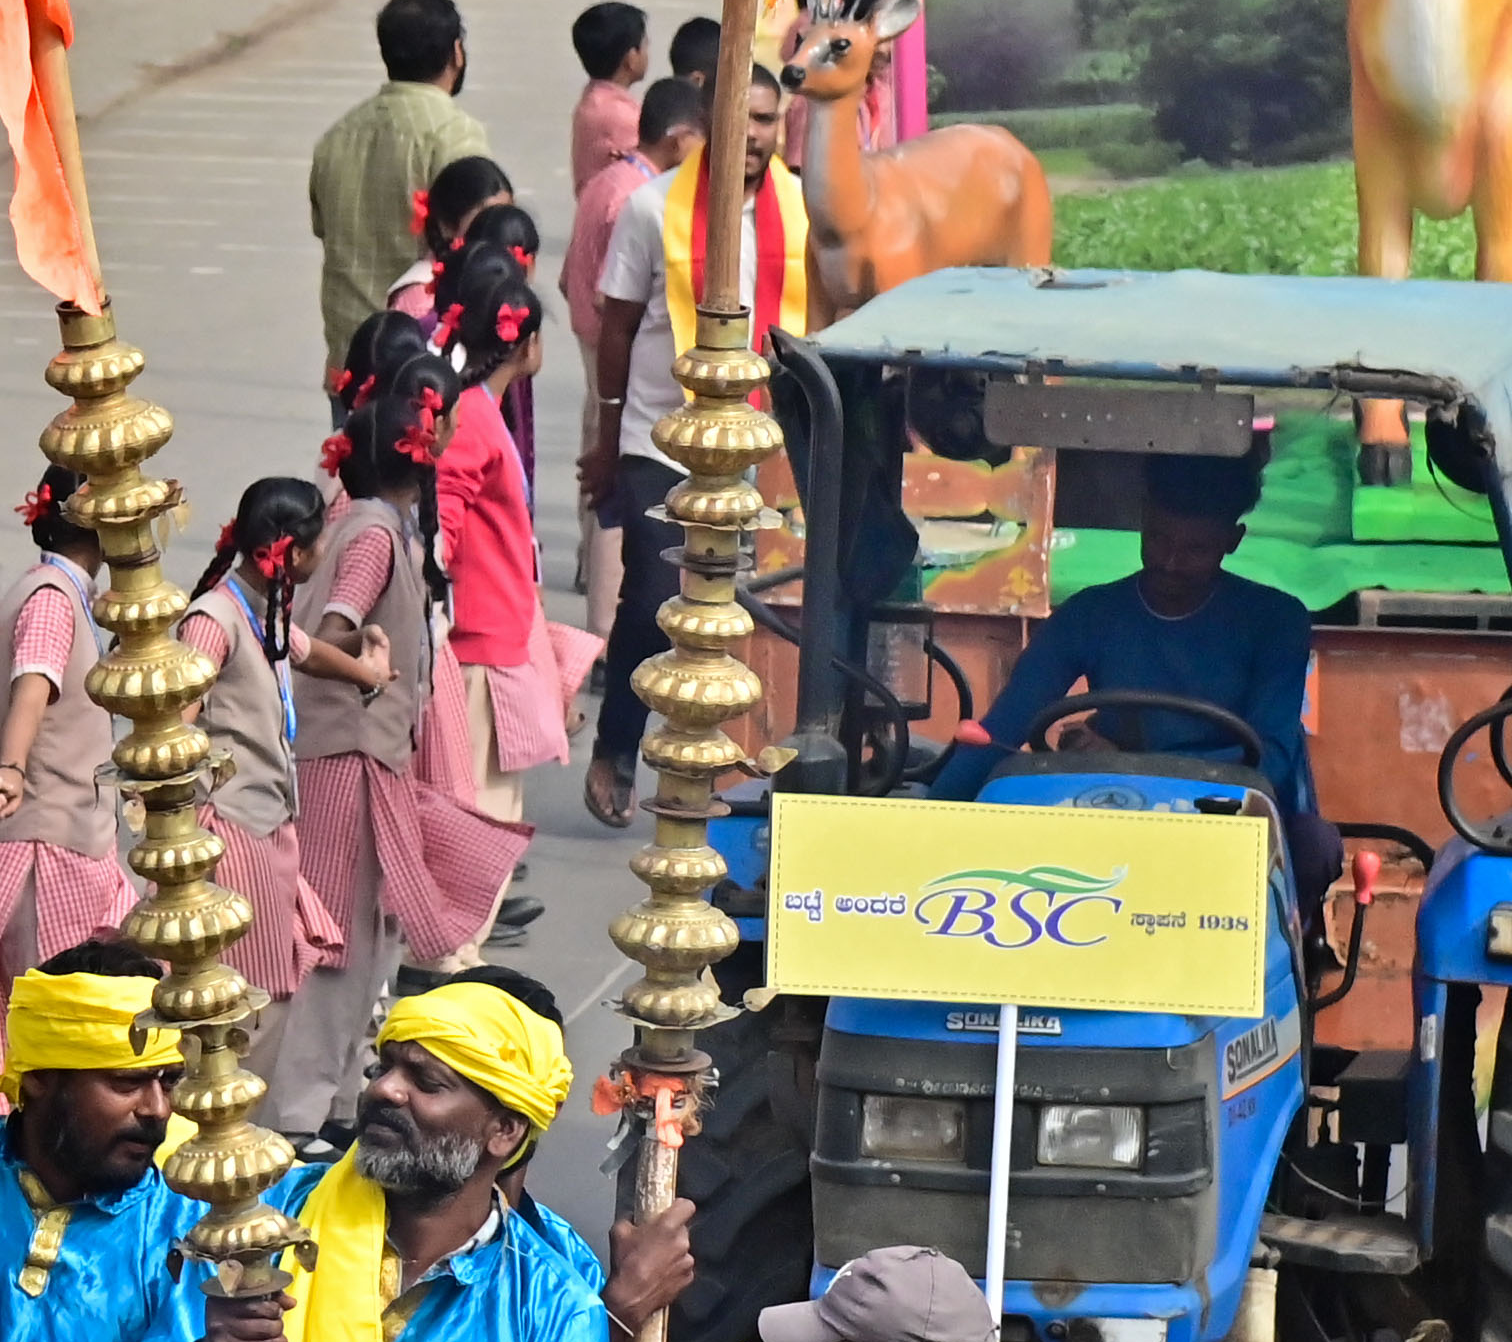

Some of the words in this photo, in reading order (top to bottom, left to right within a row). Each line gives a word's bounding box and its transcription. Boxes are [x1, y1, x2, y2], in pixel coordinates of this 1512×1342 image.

[784, 890, 824, 924] ಬಟ್ಟೆ
[834, 892, 907, 918] ಅಂದರೆ
[913, 887, 1123, 950] BSC
[1197, 913, 1251, 933] 1938
[946, 1011, 1062, 1036] SONIKA
[1226, 1016, 1279, 1085] SONALIKA
